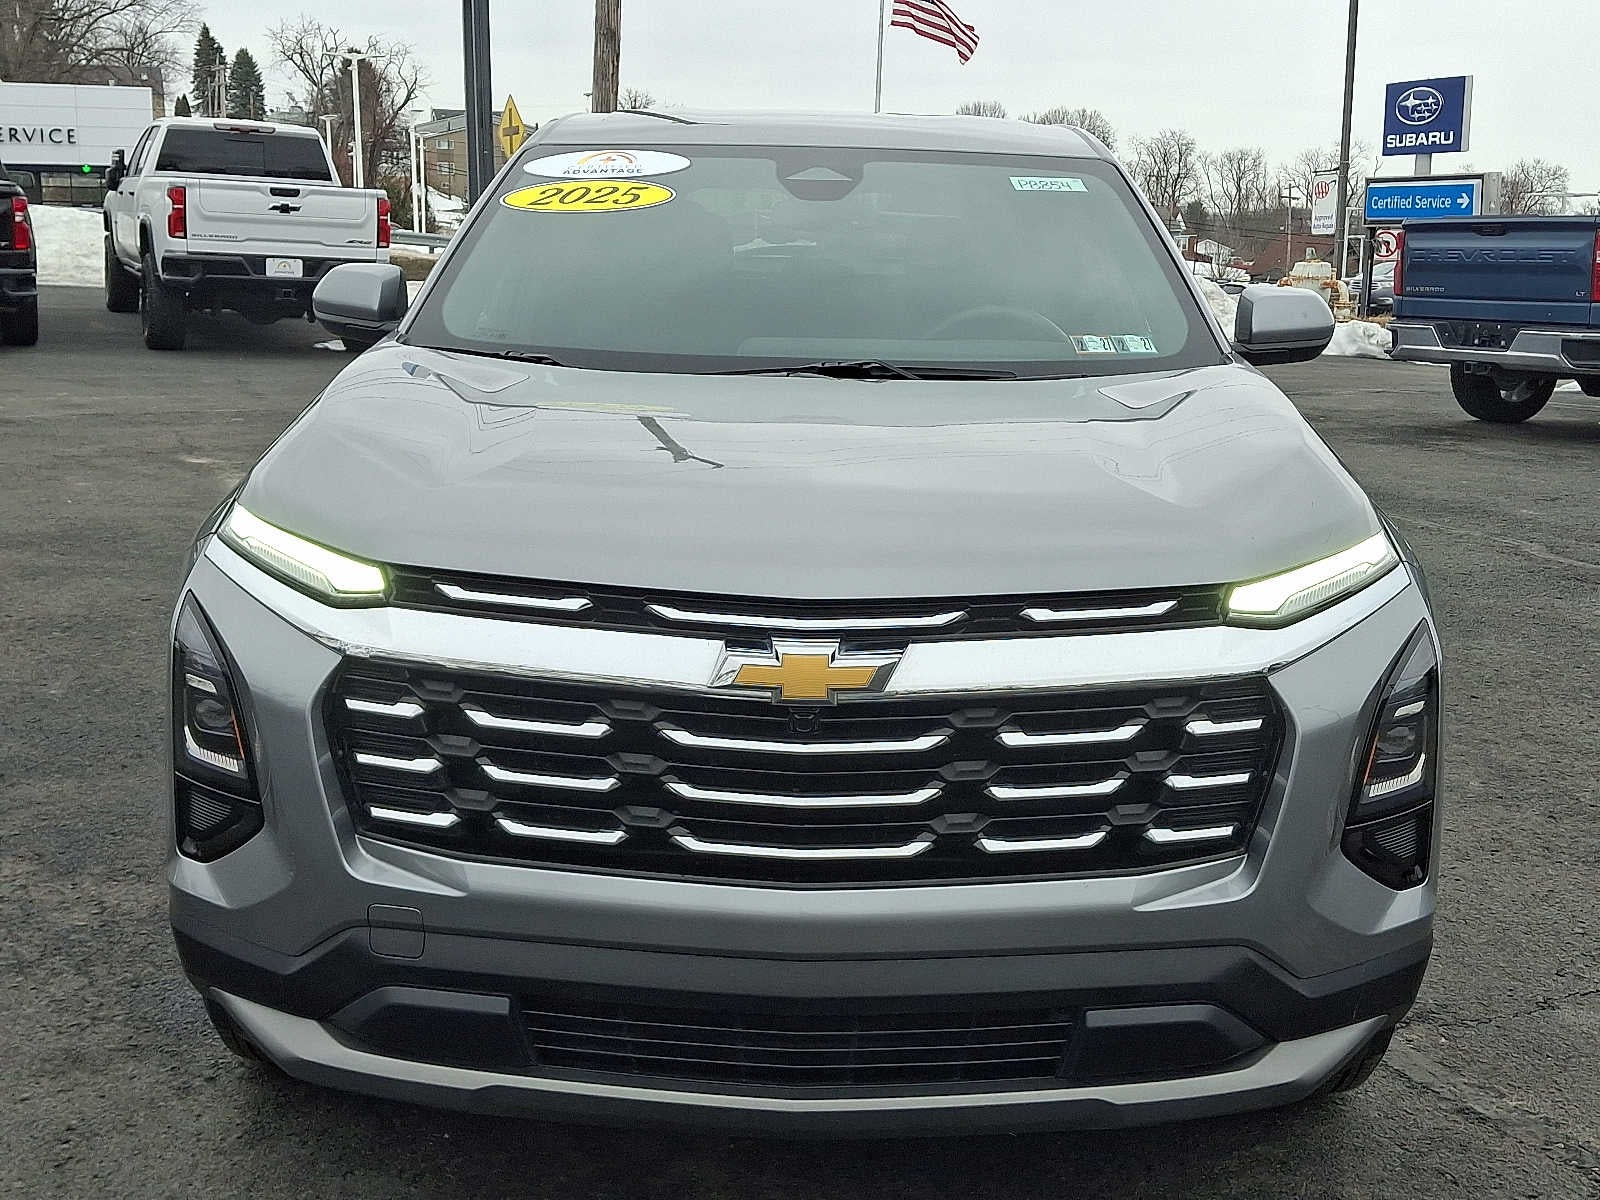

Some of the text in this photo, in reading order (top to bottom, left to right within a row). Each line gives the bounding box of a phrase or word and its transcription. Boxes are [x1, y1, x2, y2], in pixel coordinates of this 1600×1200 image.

[1386, 131, 1454, 148] SUBARU
[563, 168, 643, 176] ADVANTAGE
[526, 187, 650, 206] 2025
[1371, 194, 1452, 209] Certified Service
[1410, 248, 1577, 263] CHEVROLET
